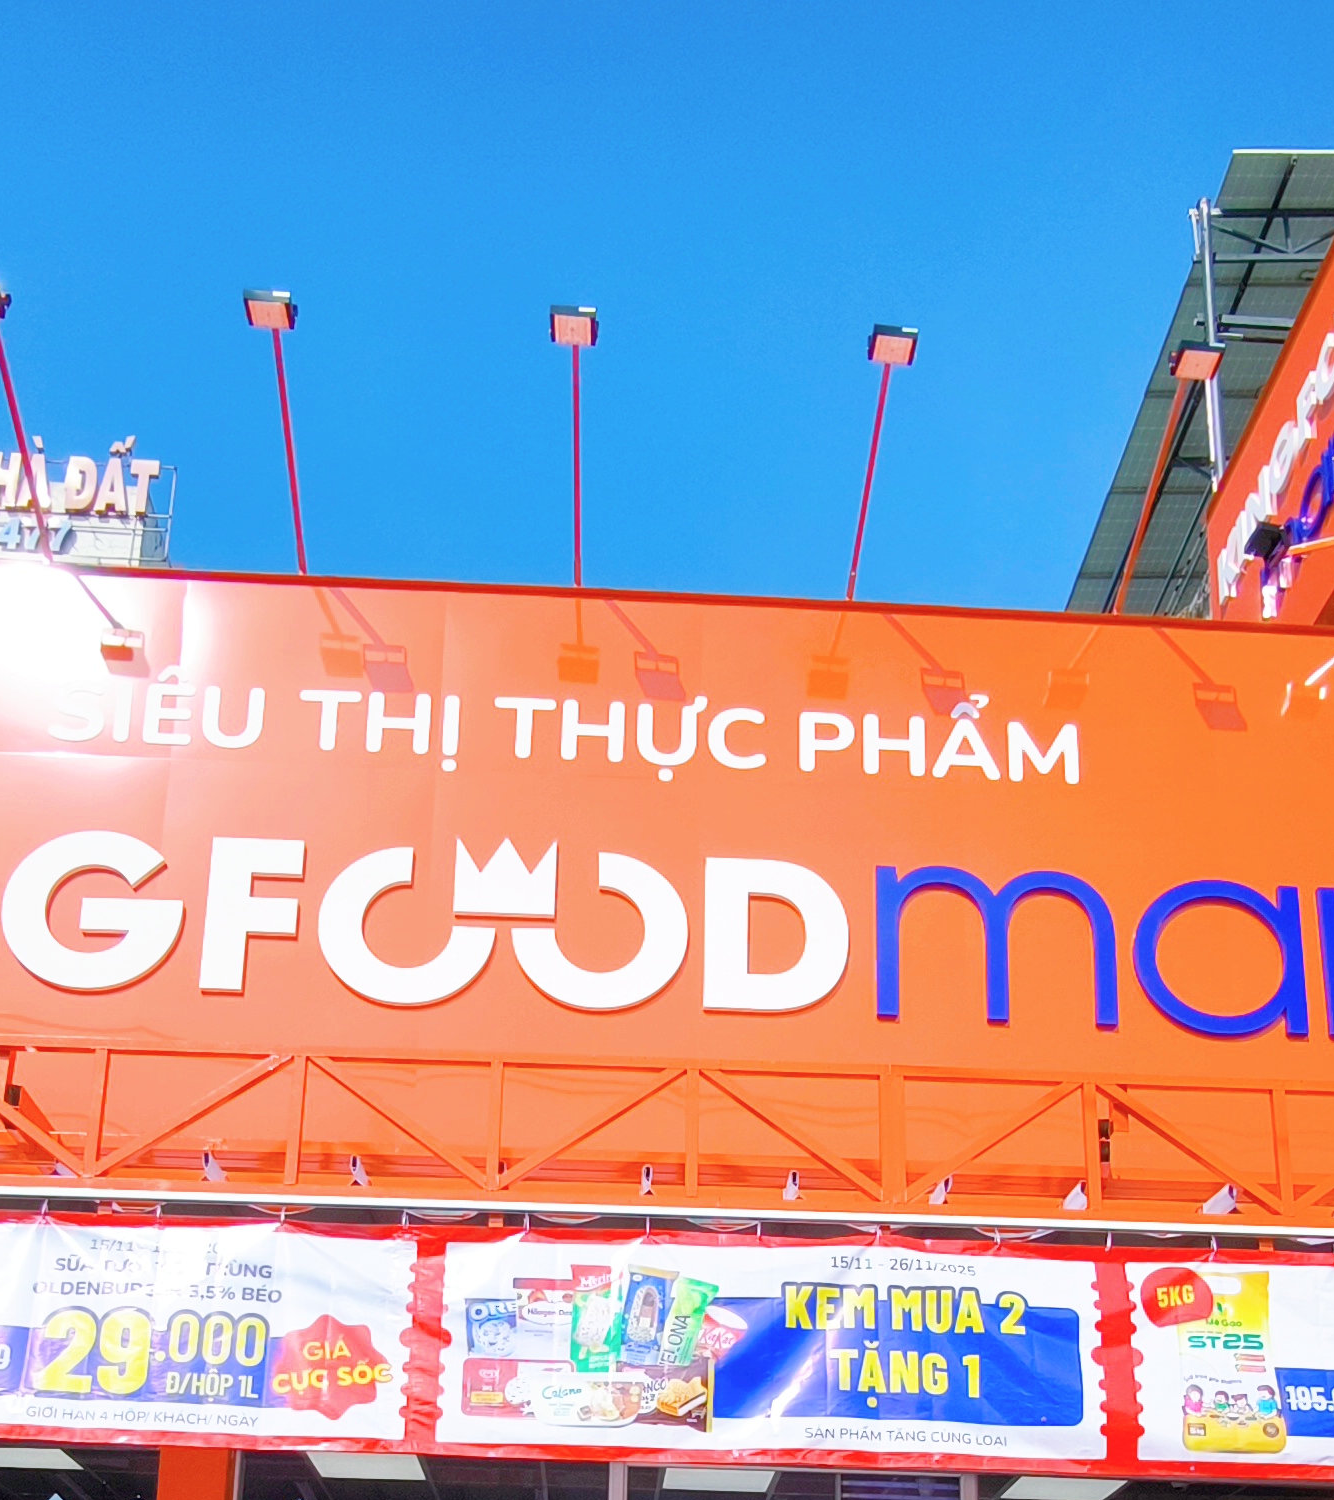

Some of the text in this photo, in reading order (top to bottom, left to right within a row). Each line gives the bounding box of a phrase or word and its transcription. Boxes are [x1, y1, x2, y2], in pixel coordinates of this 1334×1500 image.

[64, 435, 161, 515] ĐẤT
[47, 666, 1081, 785] SIÊU THỊ THỰC PHẨM
[830, 1255, 875, 1271] 15/11
[241, 1284, 283, 1303] BÉO
[1156, 1284, 1195, 1308] 5KG
[783, 1284, 1027, 1336] KEM MUA 2
[33, 1306, 267, 1395] 29.000
[302, 1336, 351, 1361] GIÁ
[1187, 1333, 1264, 1350] ST25
[166, 1371, 259, 1402] Đ/HỘP 1L
[272, 1359, 394, 1396] CỰC SỐC
[829, 1337, 981, 1408] TẶNG 1
[217, 1411, 259, 1428] NGÀY
